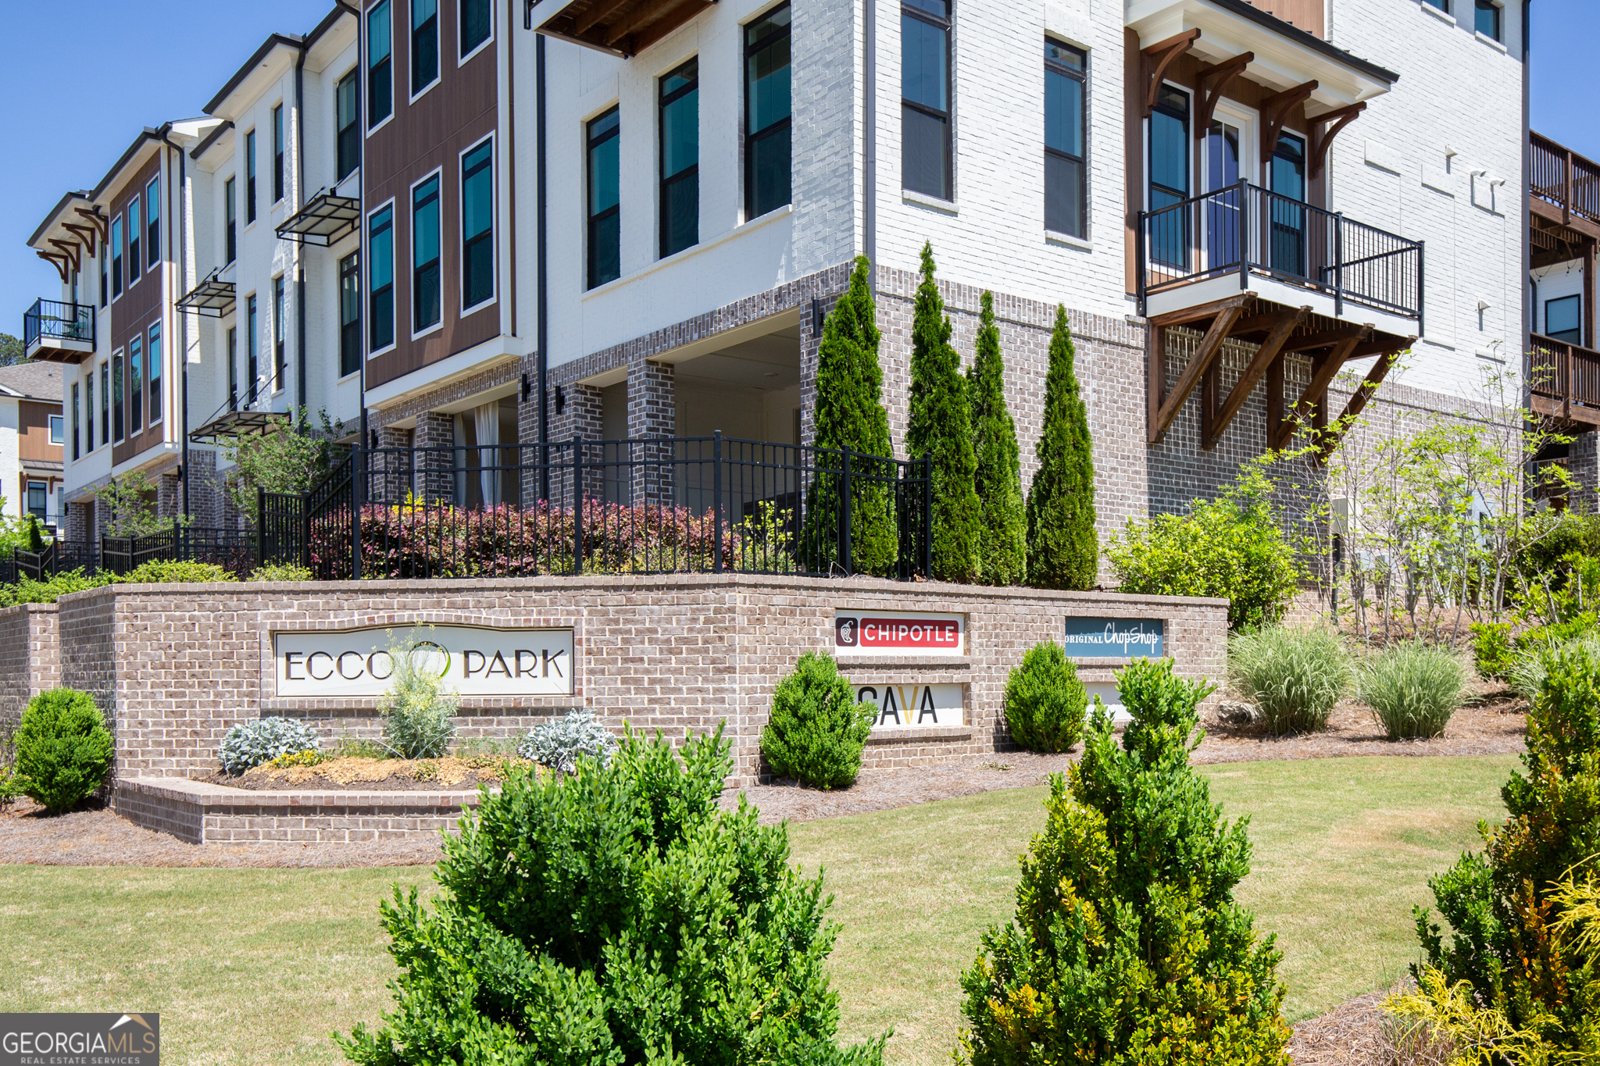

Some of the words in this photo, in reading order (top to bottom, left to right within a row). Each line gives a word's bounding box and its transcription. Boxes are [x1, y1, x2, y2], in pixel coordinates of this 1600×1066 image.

[864, 624, 955, 642] CHIPOTLE
[1065, 635, 1103, 644] ORIGINAL
[284, 651, 396, 680] ECCO
[463, 649, 564, 679] PARK
